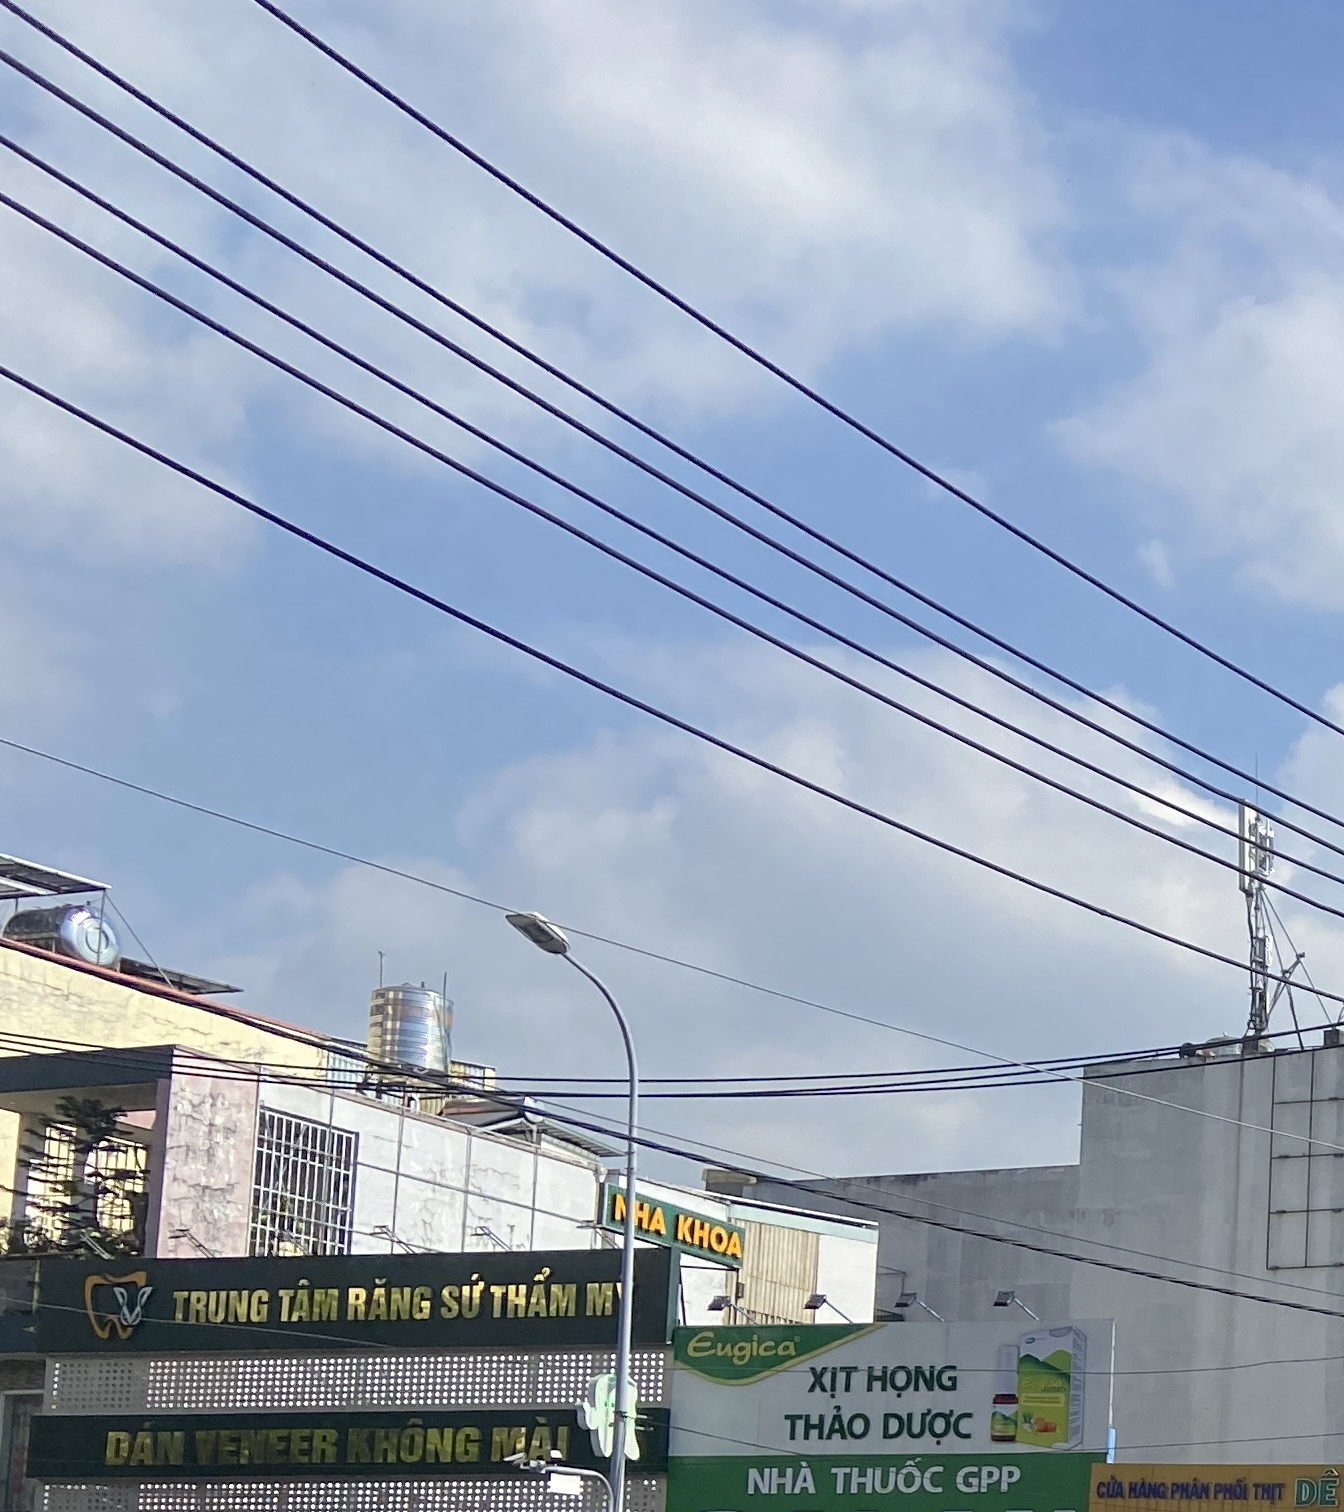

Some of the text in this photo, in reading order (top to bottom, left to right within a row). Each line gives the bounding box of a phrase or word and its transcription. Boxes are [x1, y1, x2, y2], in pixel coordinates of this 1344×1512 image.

[678, 1214, 743, 1259] KHOA
[172, 1289, 269, 1325] TRUNG
[278, 1279, 339, 1323] TÂM
[346, 1279, 431, 1321] RĂNG
[440, 1272, 484, 1321] SỨ
[490, 1266, 577, 1319] THẨM
[687, 1331, 797, 1363] Eugica
[808, 1365, 958, 1398] XỊT HỌNG
[105, 1416, 570, 1466] DÁN VENEER KHÔNG MÀI
[784, 1405, 973, 1445] THẢO DƯỢC
[747, 1457, 1022, 1495] NHÀ THUỐC GPP
[1097, 1474, 1124, 1500] CỬA
[1128, 1477, 1166, 1500] HÀNG
[1170, 1477, 1211, 1500] PHÂN
[1214, 1476, 1248, 1500] PHỐI
[1253, 1482, 1286, 1505] THỊT
[1295, 1467, 1340, 1507] DÊ
